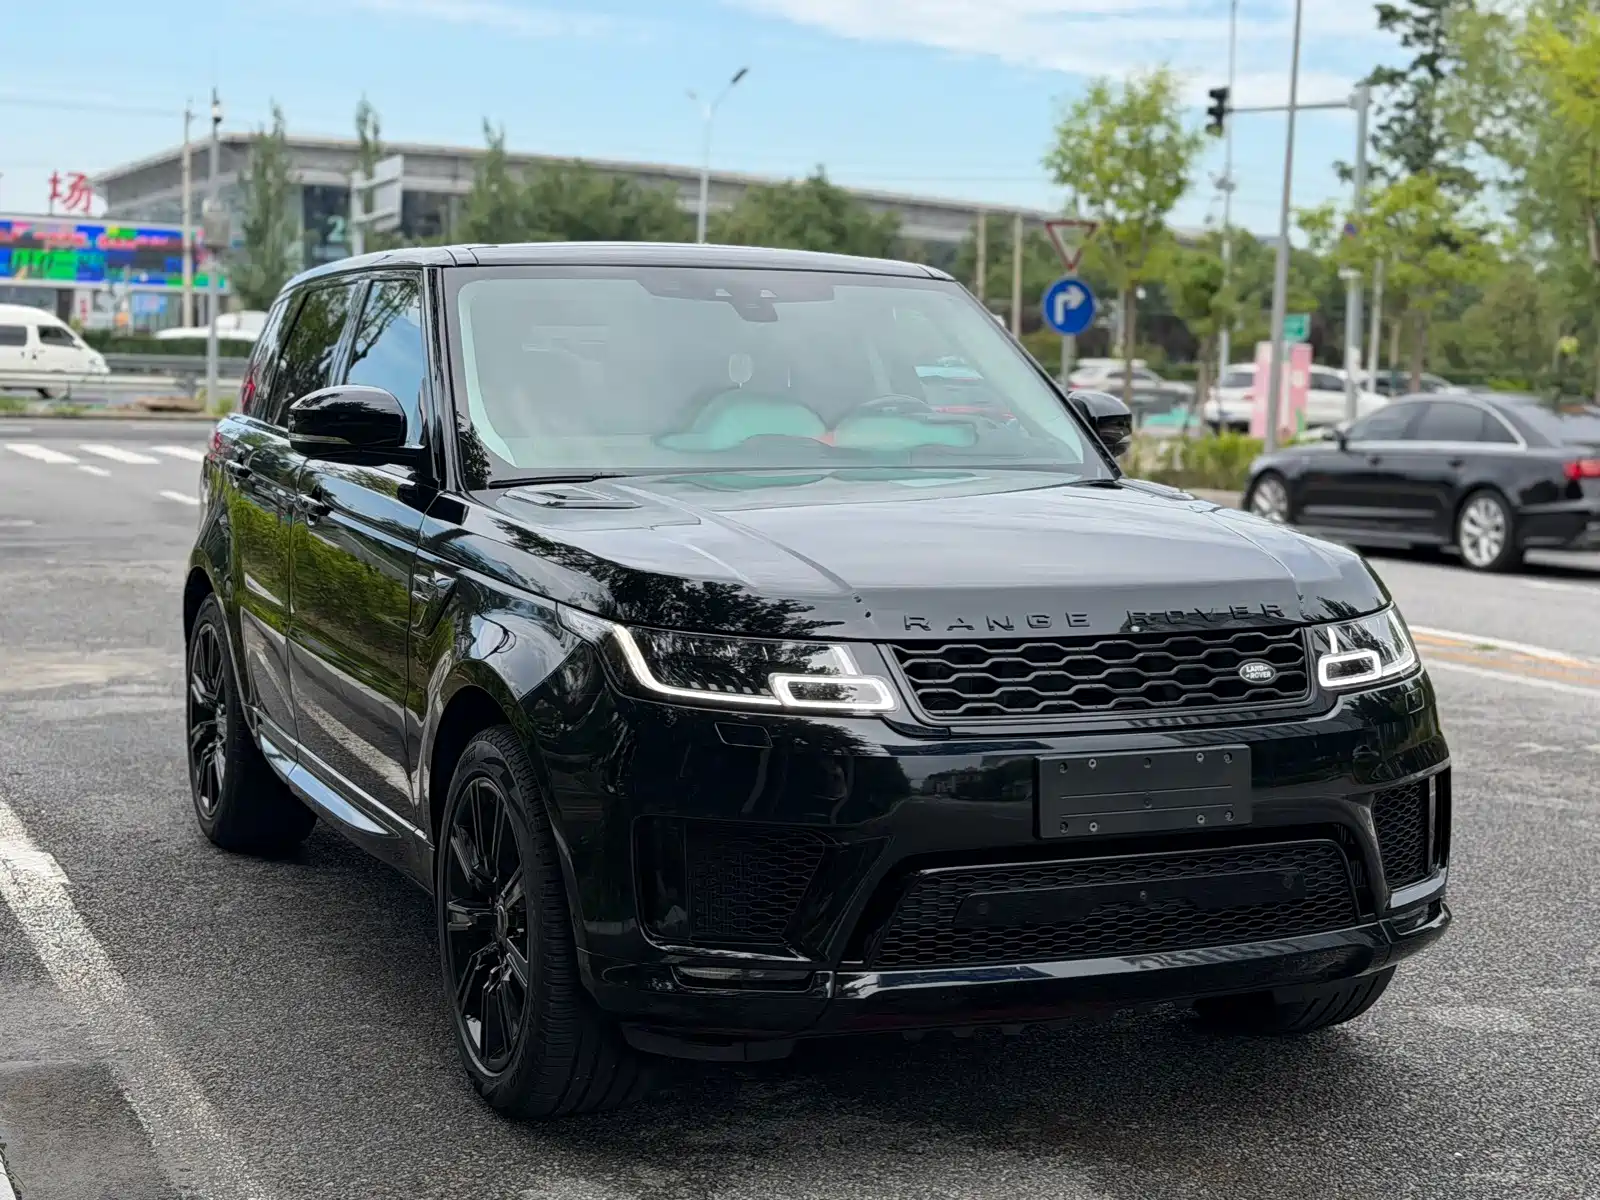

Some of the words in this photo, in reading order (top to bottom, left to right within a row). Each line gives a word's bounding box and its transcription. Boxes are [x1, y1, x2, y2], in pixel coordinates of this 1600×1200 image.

[48, 169, 93, 215] 场
[904, 611, 1090, 632] RANGE
[1126, 603, 1285, 626] ROVER
[1246, 665, 1264, 673] LAND
[1250, 671, 1271, 679] ROVER
